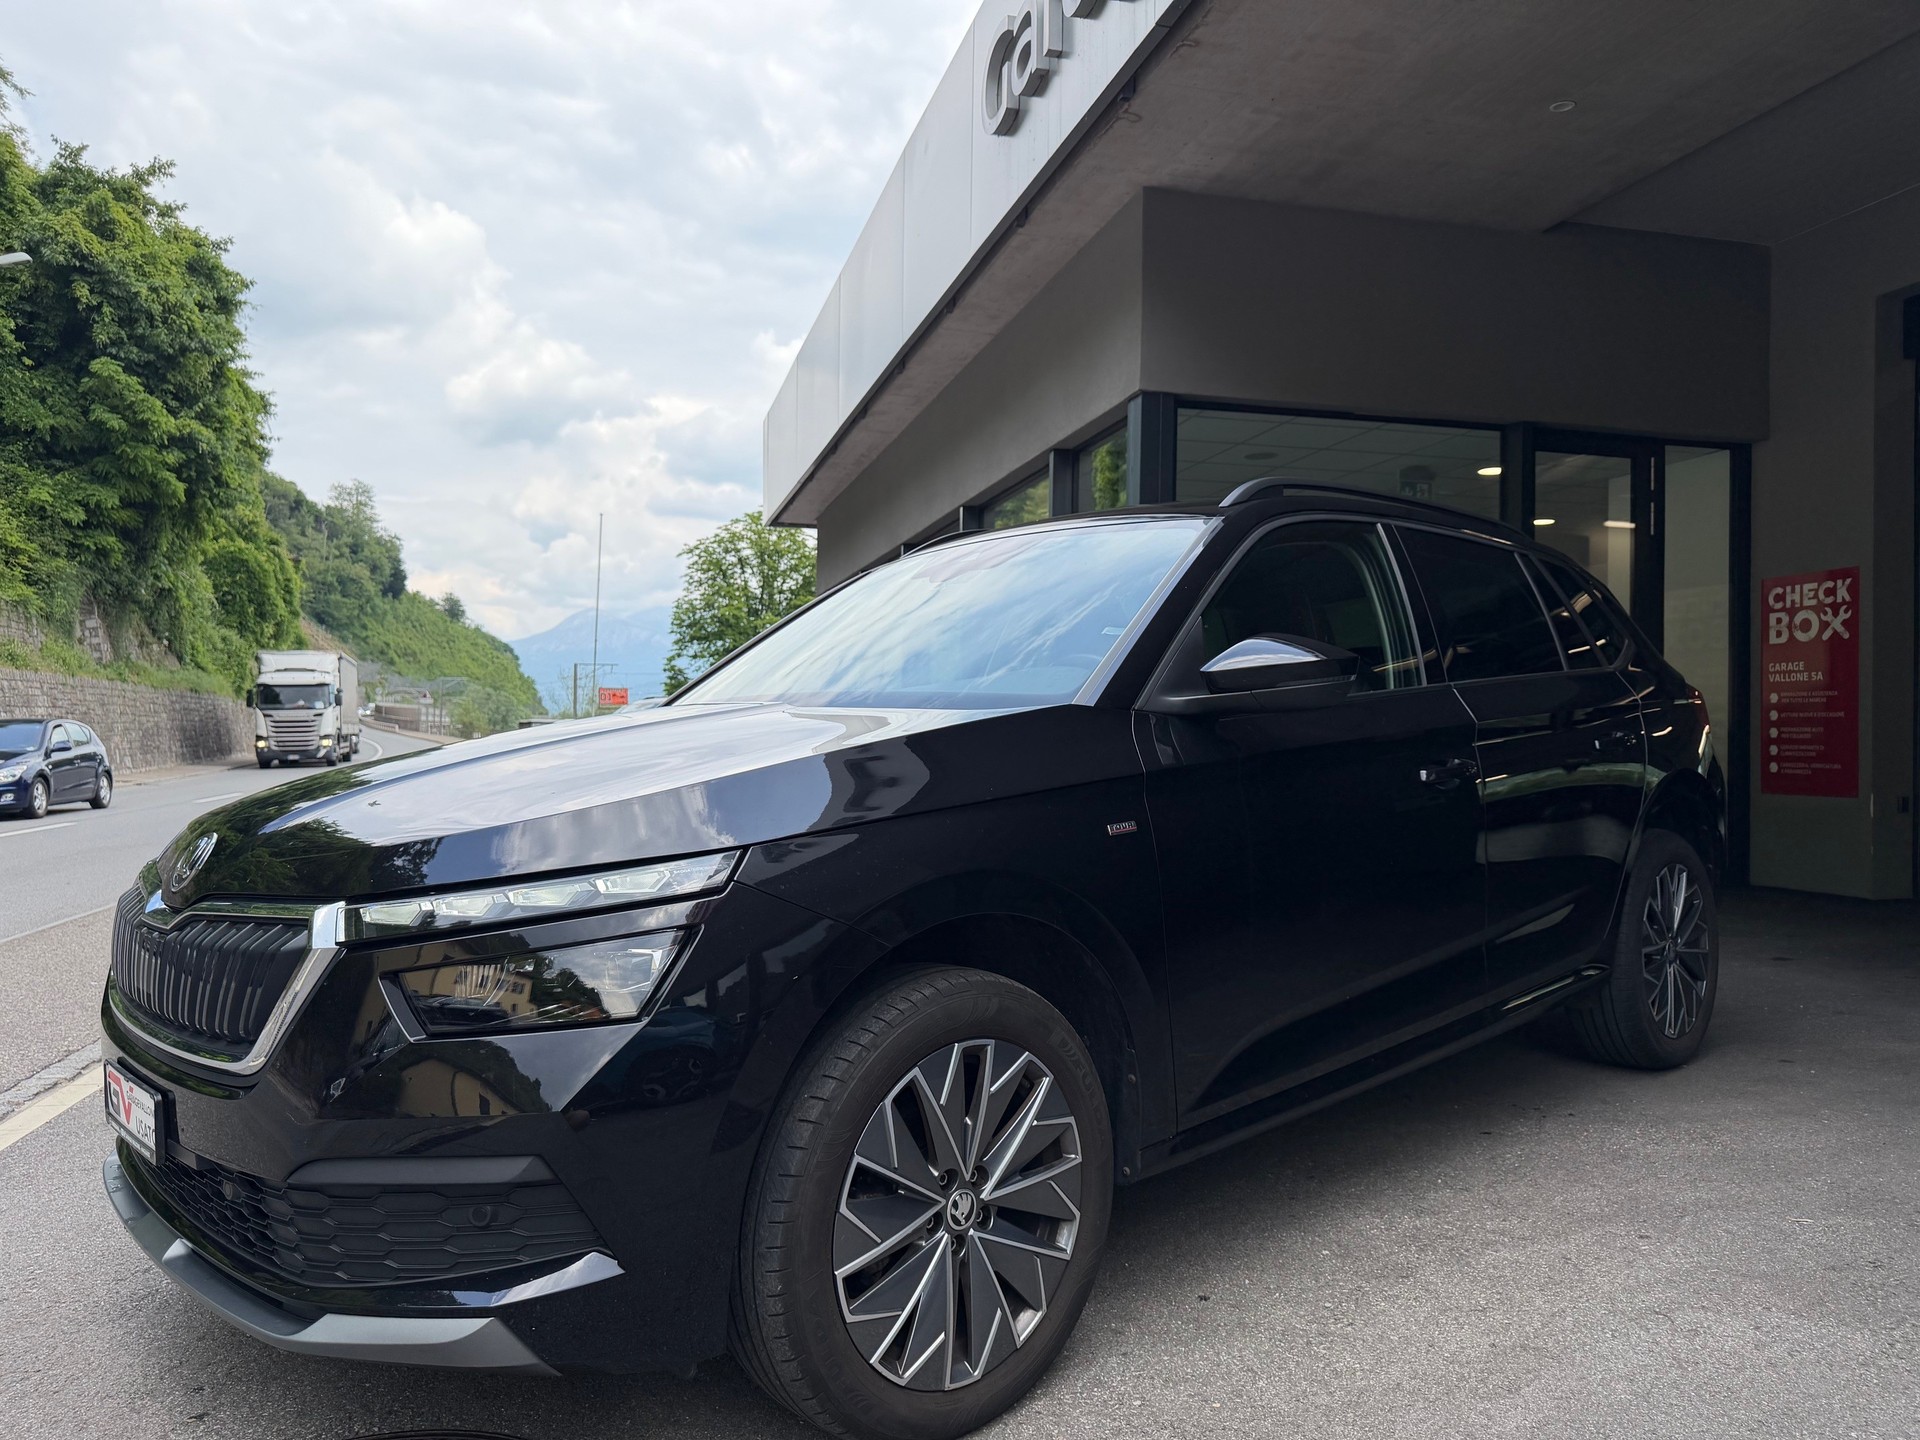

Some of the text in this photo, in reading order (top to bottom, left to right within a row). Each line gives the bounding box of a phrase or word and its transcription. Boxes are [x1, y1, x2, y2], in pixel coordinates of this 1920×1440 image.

[1768, 578, 1853, 610] CHECK
[1768, 661, 1805, 672] GARAGE
[1768, 671, 1824, 682] VALLONE SA
